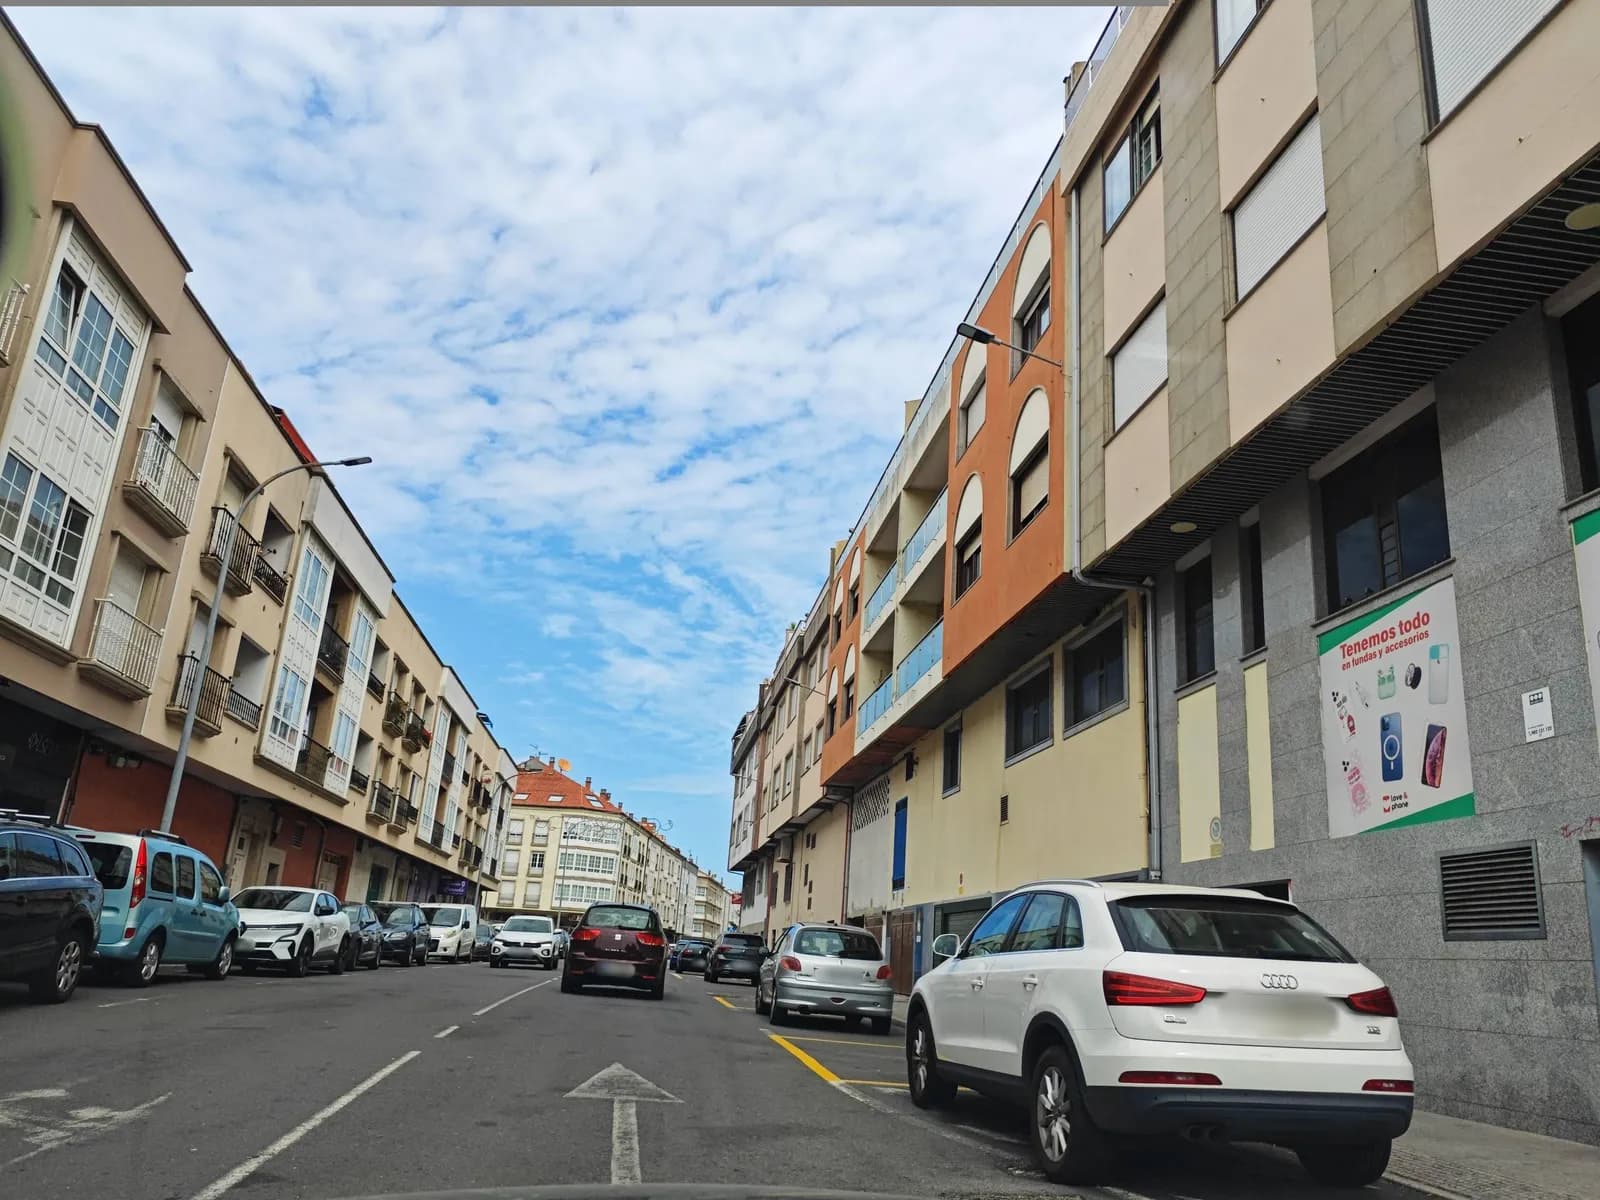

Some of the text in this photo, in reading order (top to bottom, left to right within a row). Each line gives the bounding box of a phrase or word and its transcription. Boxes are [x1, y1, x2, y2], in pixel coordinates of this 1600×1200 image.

[1340, 611, 1430, 659] Tenemos todo
[1342, 630, 1430, 671] en fundas y accesorios
[1391, 793, 1403, 802] love
[1392, 802, 1408, 811] phone
